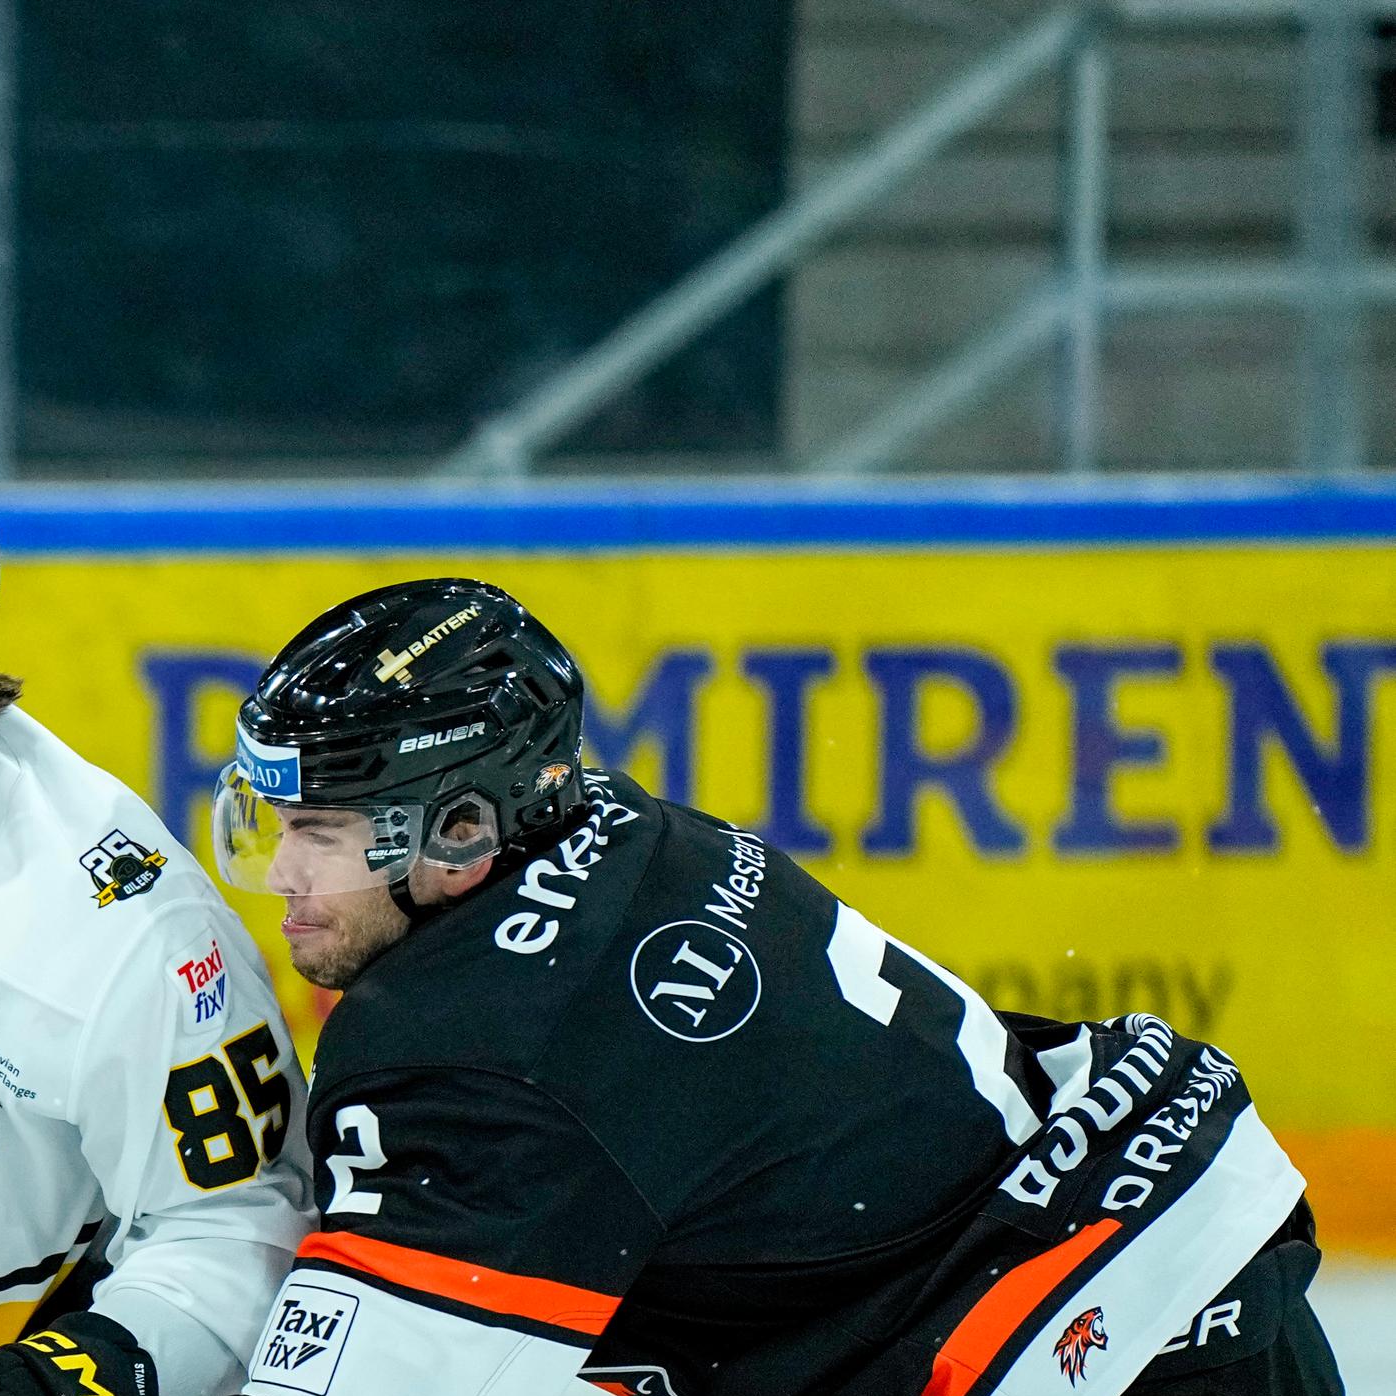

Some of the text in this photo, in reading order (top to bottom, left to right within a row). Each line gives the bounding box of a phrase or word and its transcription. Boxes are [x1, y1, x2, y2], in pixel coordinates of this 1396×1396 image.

[408, 604, 481, 658] BATTERY
[398, 721, 486, 754] BAUER
[122, 870, 156, 896] OILERS
[176, 939, 224, 994] Taxi
[195, 990, 222, 1023] fix
[161, 1018, 292, 1193] 85
[325, 1104, 389, 1215] 2
[276, 1299, 345, 1342] Taxi
[263, 1334, 297, 1370] fix
